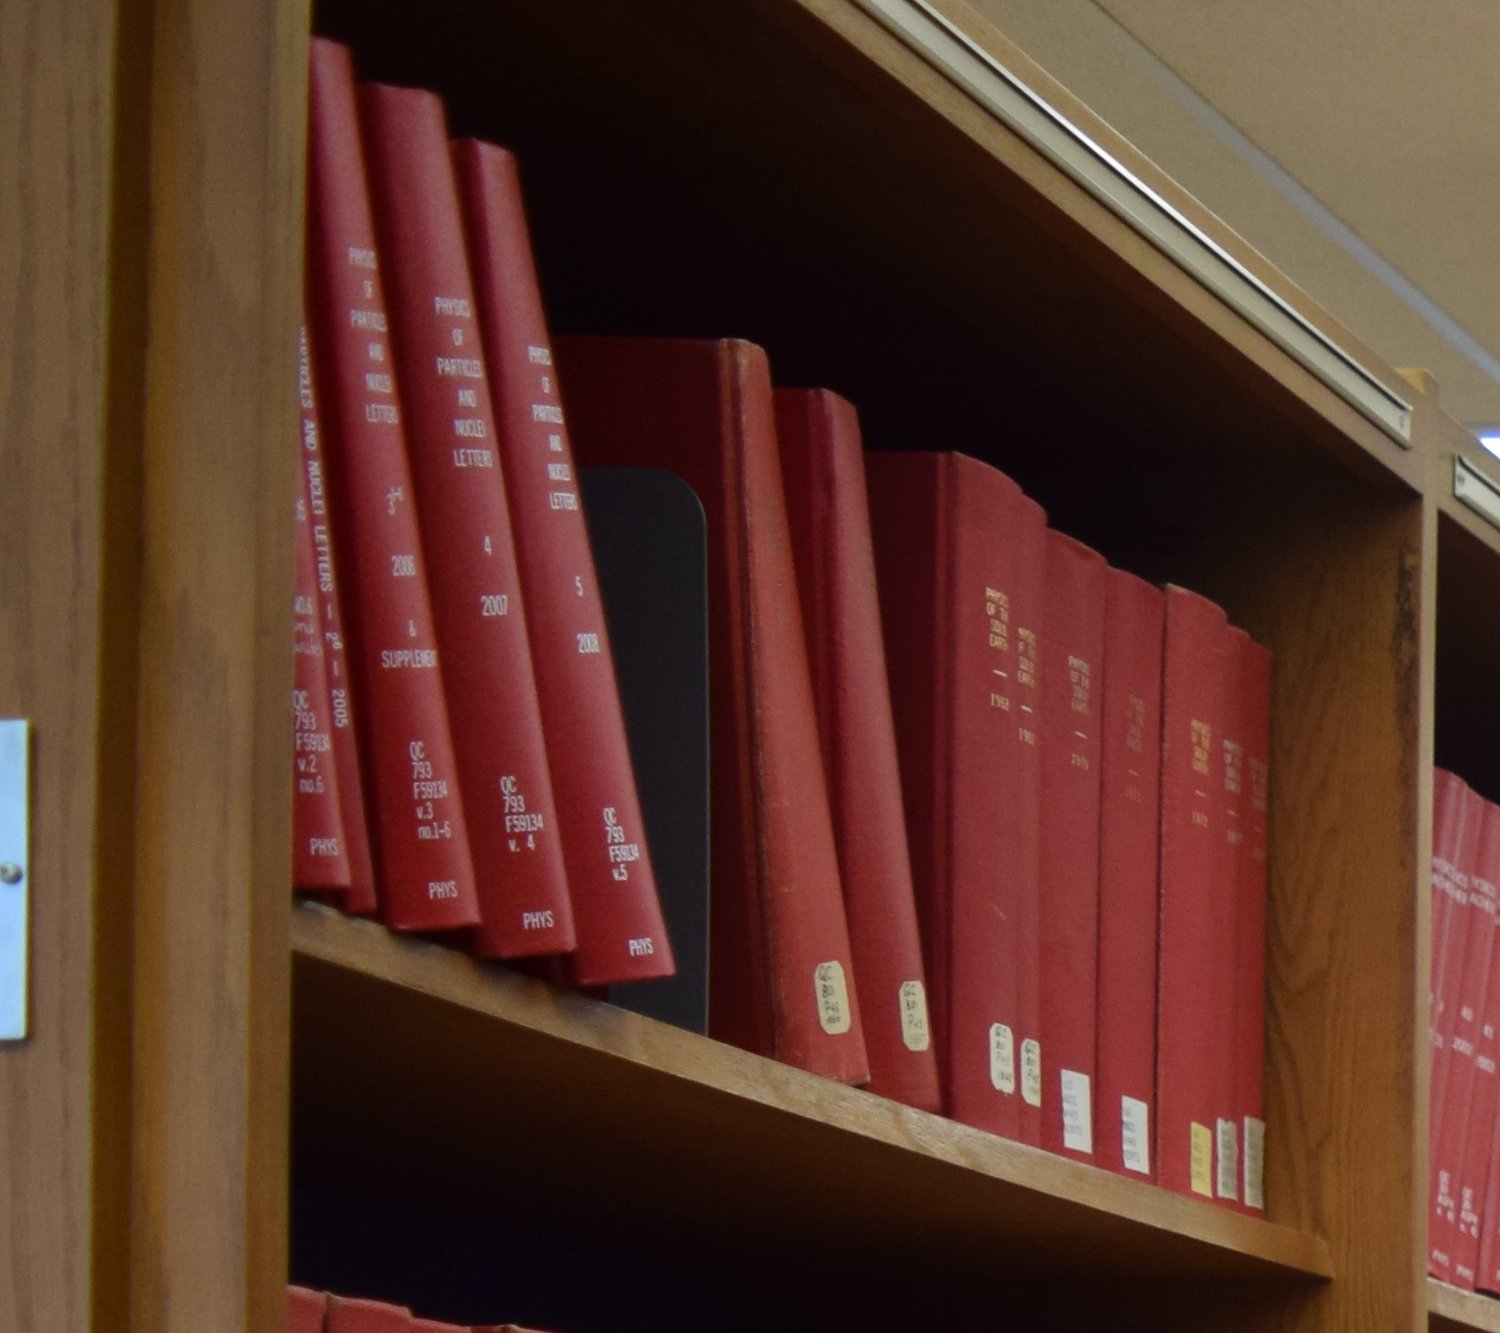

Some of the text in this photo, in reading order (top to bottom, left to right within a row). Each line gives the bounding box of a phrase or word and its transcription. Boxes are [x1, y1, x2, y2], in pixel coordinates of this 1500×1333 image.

[435, 296, 471, 317] PHYSICS
[453, 328, 463, 346] OF
[437, 358, 483, 378] PARTICLES
[458, 390, 477, 407] AND
[454, 419, 485, 438] NUCLEI
[454, 449, 493, 468] LETTERS
[484, 536, 492, 556] 4
[304, 418, 349, 727] AND NUCLEI LETTERS 2005
[576, 576, 584, 596] 5
[481, 595, 507, 615] 2007
[410, 741, 425, 762] QC
[413, 762, 432, 779] 793
[414, 782, 448, 799] F59134
[500, 776, 516, 794] QC
[417, 803, 434, 819] v.3
[502, 796, 525, 813] 793
[505, 814, 544, 833] F59134
[603, 807, 618, 827] QC
[527, 835, 536, 851] 4
[606, 826, 625, 842] 793
[310, 838, 339, 856] PHYS
[429, 881, 457, 898] PHYS
[523, 911, 554, 929] PHYS
[629, 938, 654, 956] PHYS
